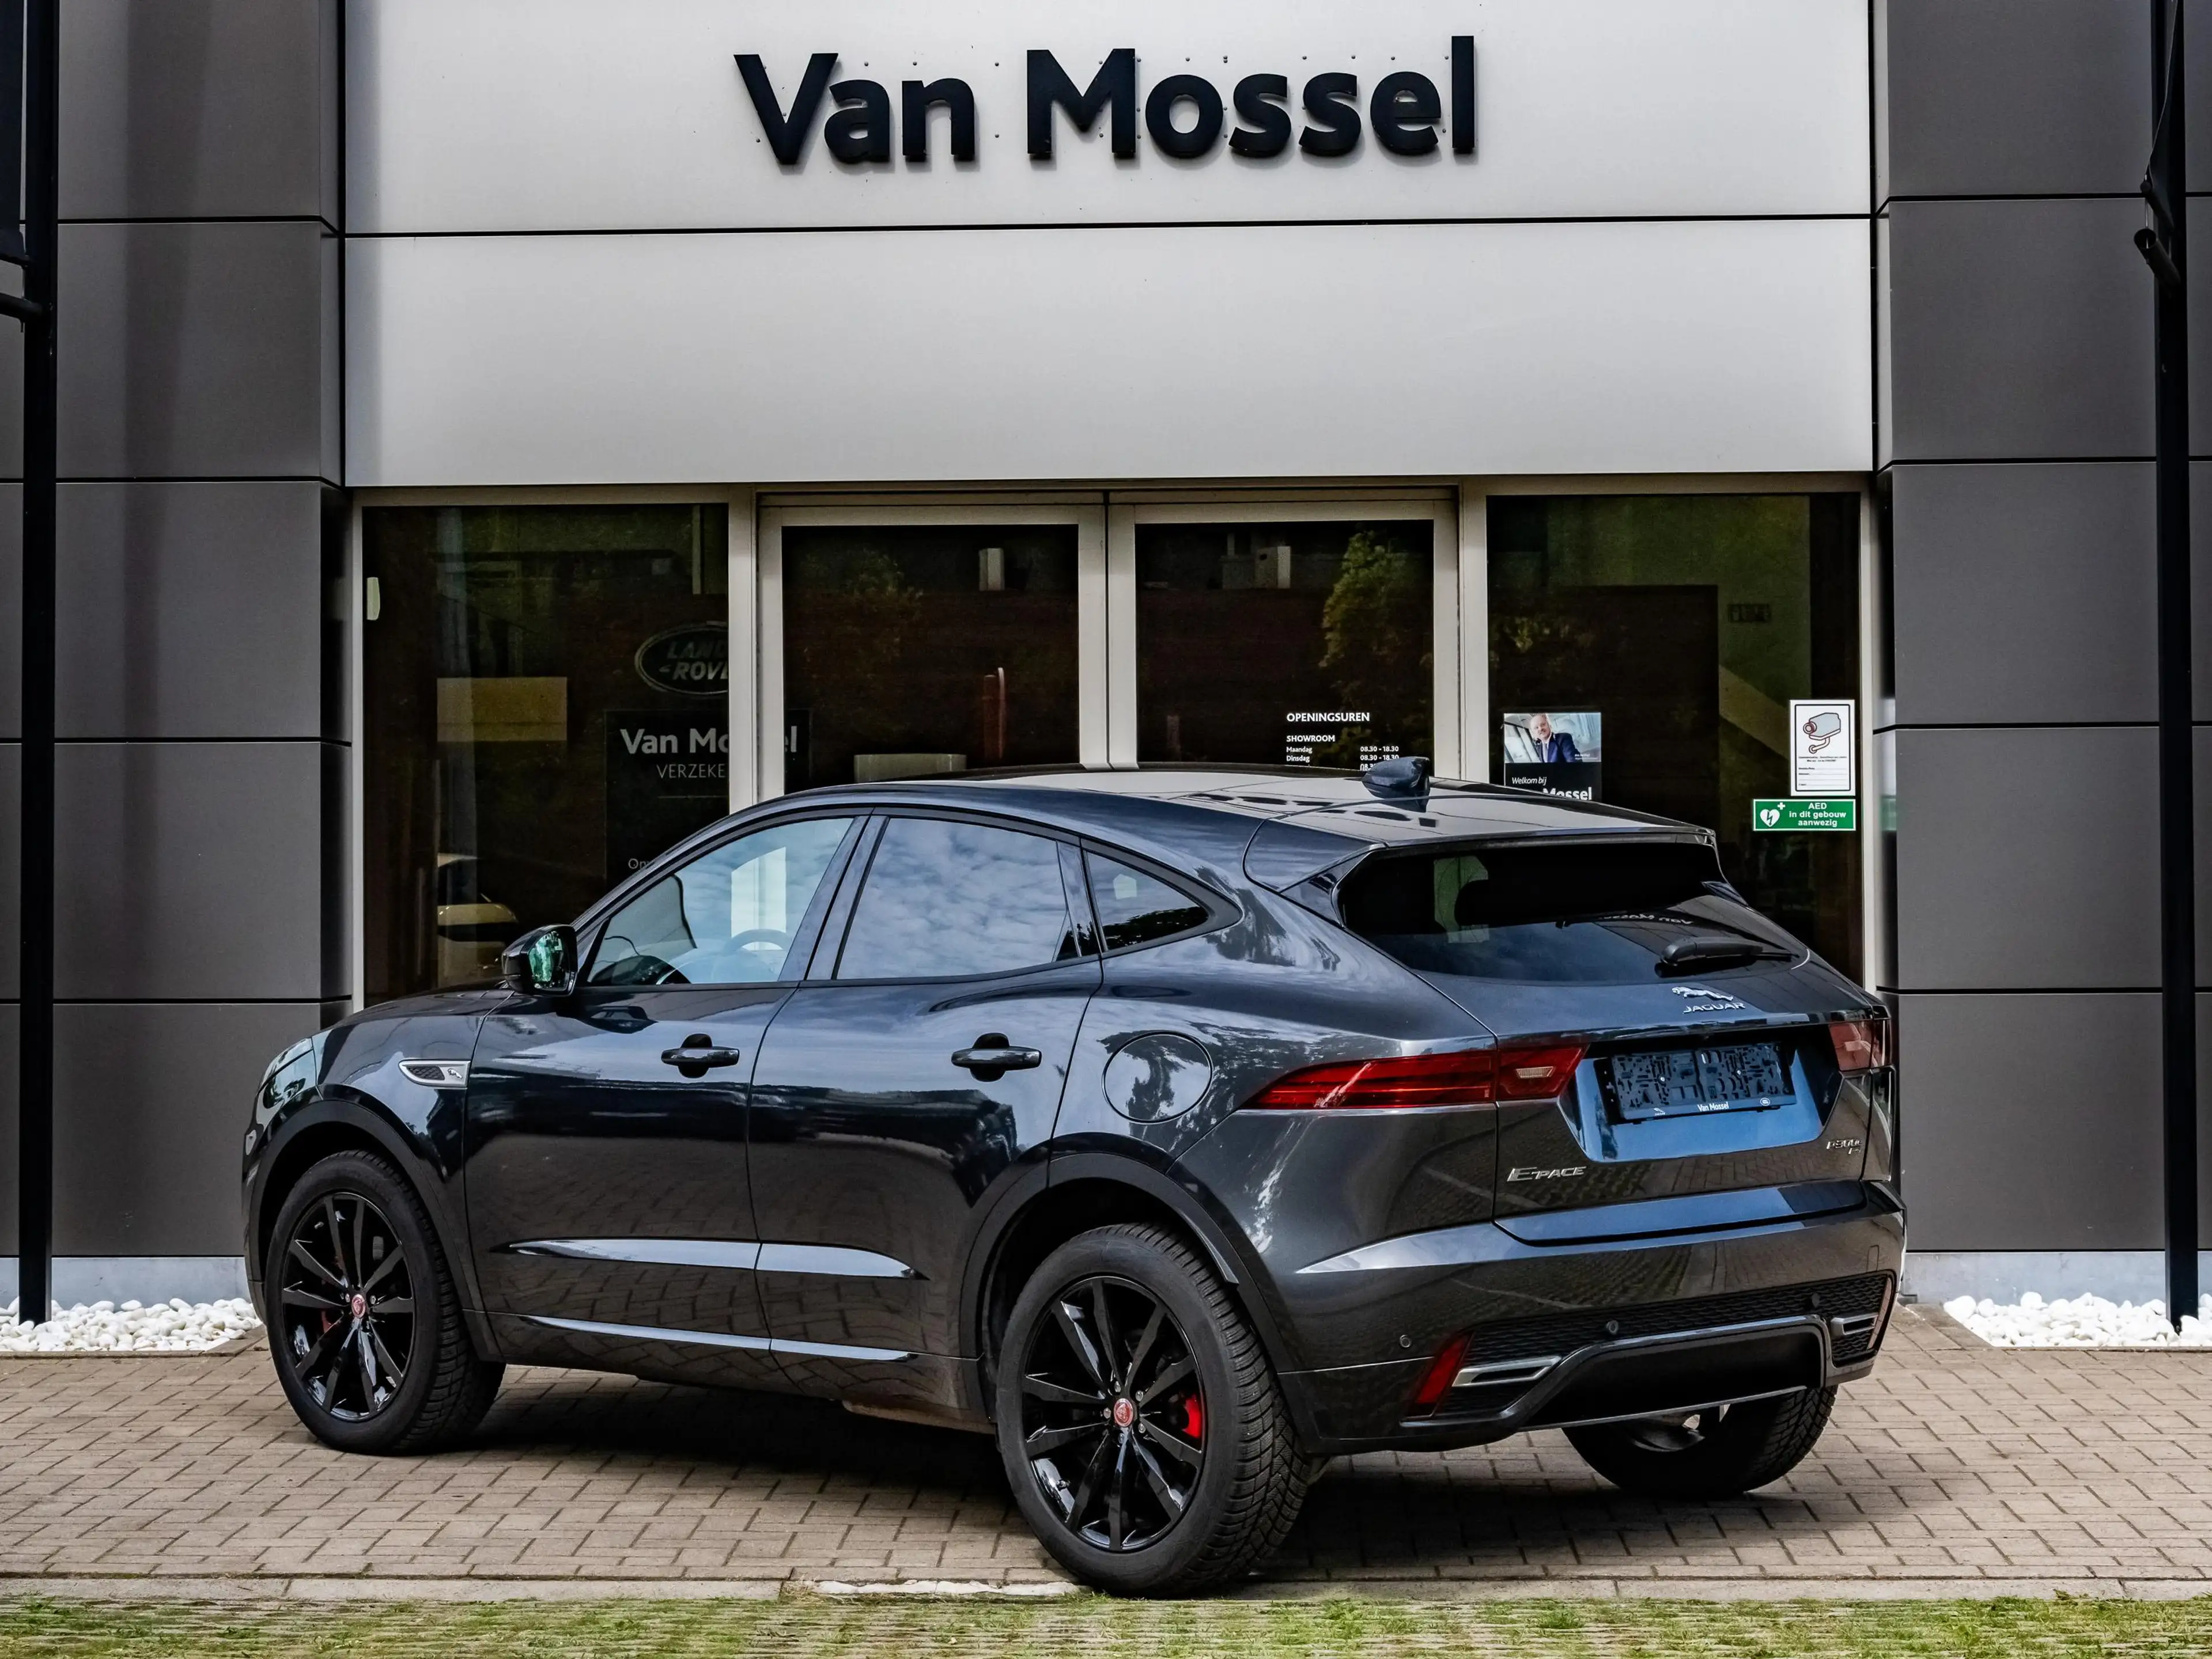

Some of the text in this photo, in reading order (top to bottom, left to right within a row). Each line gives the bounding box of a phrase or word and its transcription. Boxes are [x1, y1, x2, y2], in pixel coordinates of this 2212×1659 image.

[733, 35, 1475, 165] Van Mossel
[672, 661, 728, 680] ROV
[1286, 713, 1370, 722] OPENINGSUREN
[620, 729, 678, 754] Van
[657, 764, 725, 778] VERZEKE
[1512, 777, 1547, 786] Welkom bij
[1813, 811, 1847, 819] gebouw
[1798, 819, 1837, 827] aanwezig
[1682, 1002, 1746, 1014] JAGUAR
[1697, 1101, 1729, 1112] Van Mossel
